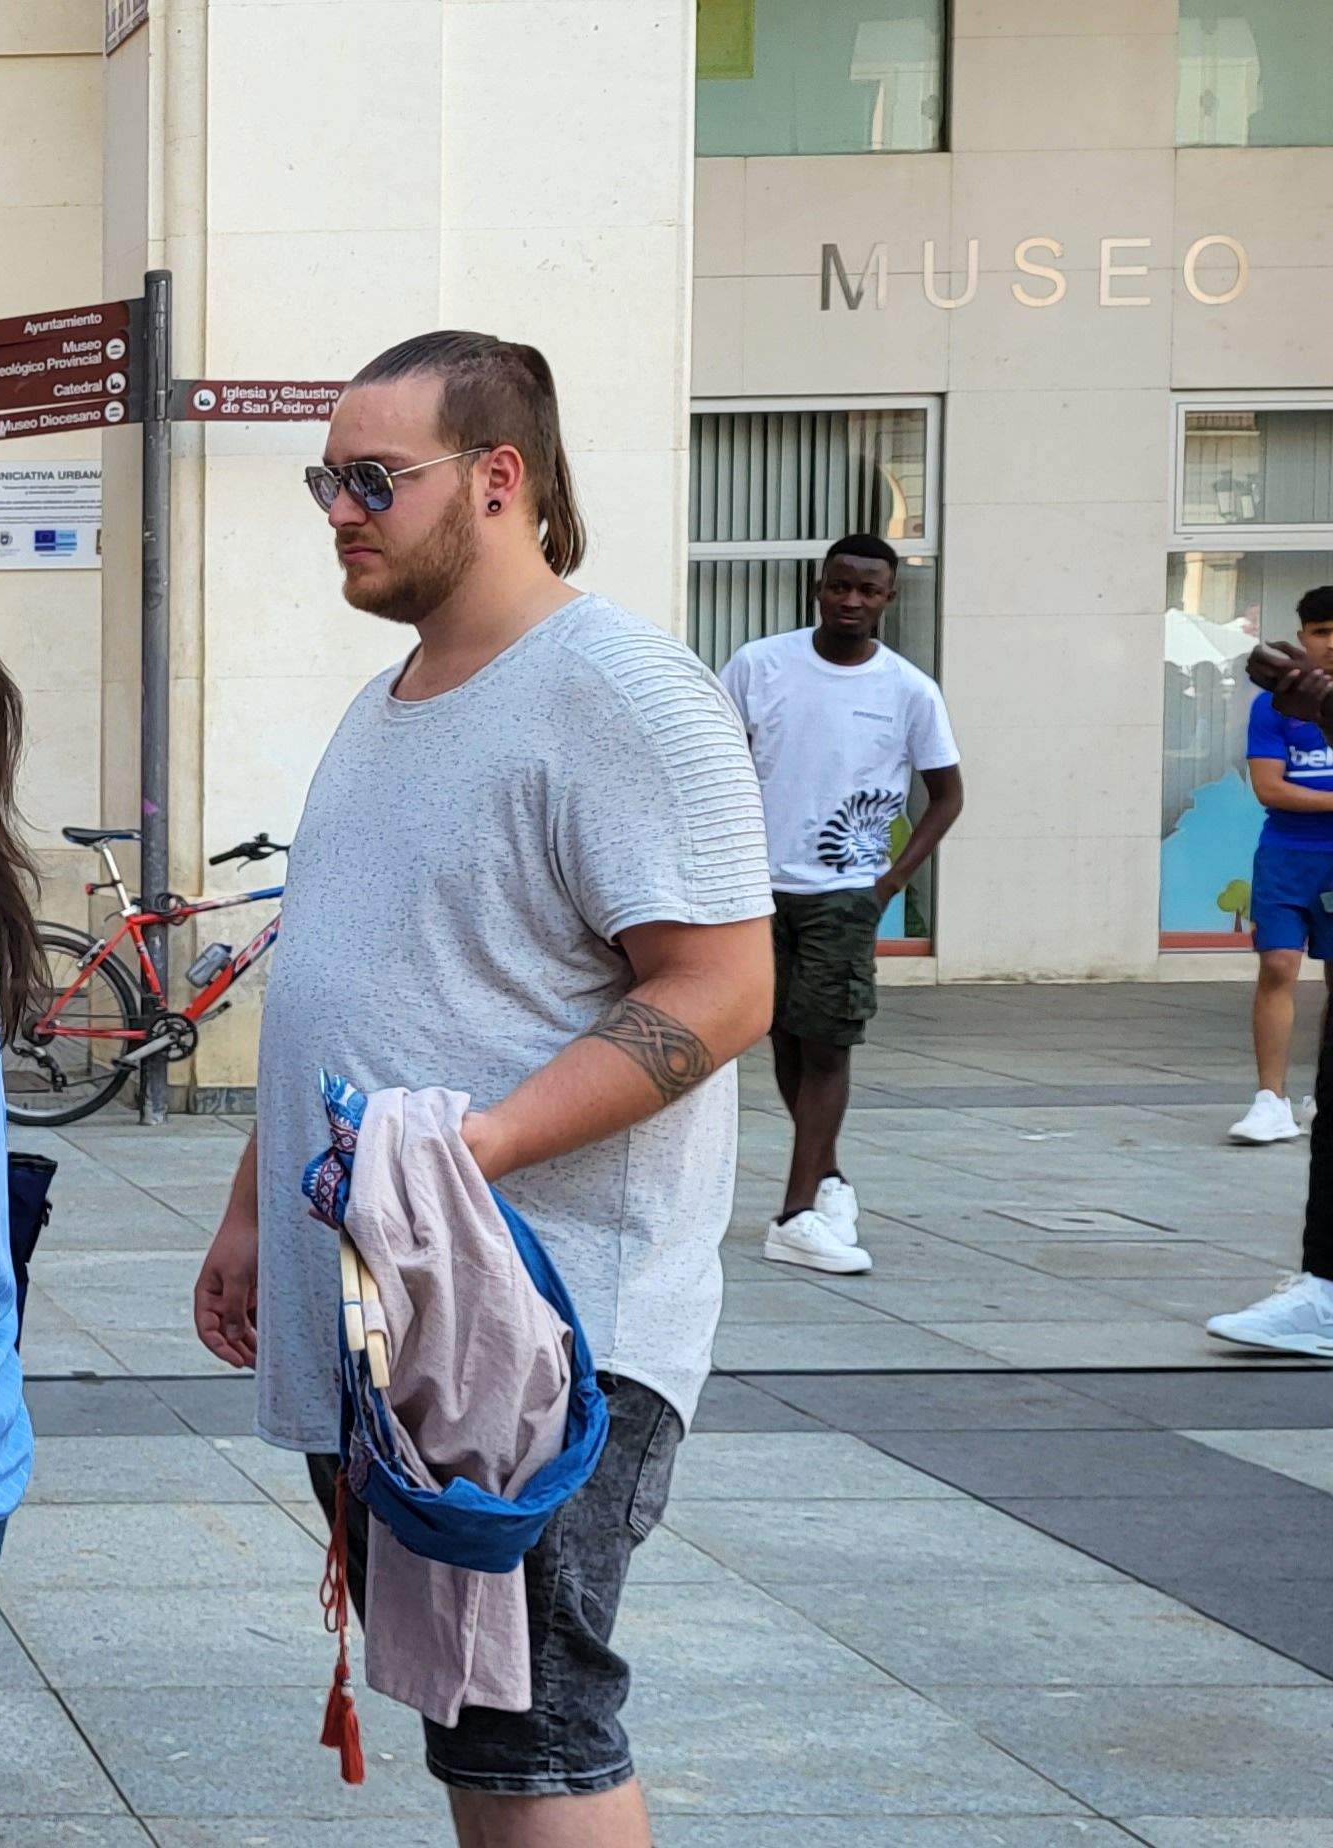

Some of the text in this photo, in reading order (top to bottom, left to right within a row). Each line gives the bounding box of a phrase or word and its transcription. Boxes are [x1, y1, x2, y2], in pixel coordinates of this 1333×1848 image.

[820, 234, 1249, 310] MUSEO
[23, 313, 103, 336] Ayuntamiento
[62, 339, 102, 354] Museo
[47, 352, 102, 370] Provincial
[53, 380, 103, 397] Catedral
[222, 386, 340, 401] Iglesia y Claustro
[221, 400, 239, 414] de
[242, 401, 270, 414] San
[272, 401, 315, 414] Pedro
[317, 401, 330, 414] el
[0, 409, 102, 433] Museo Diocesano
